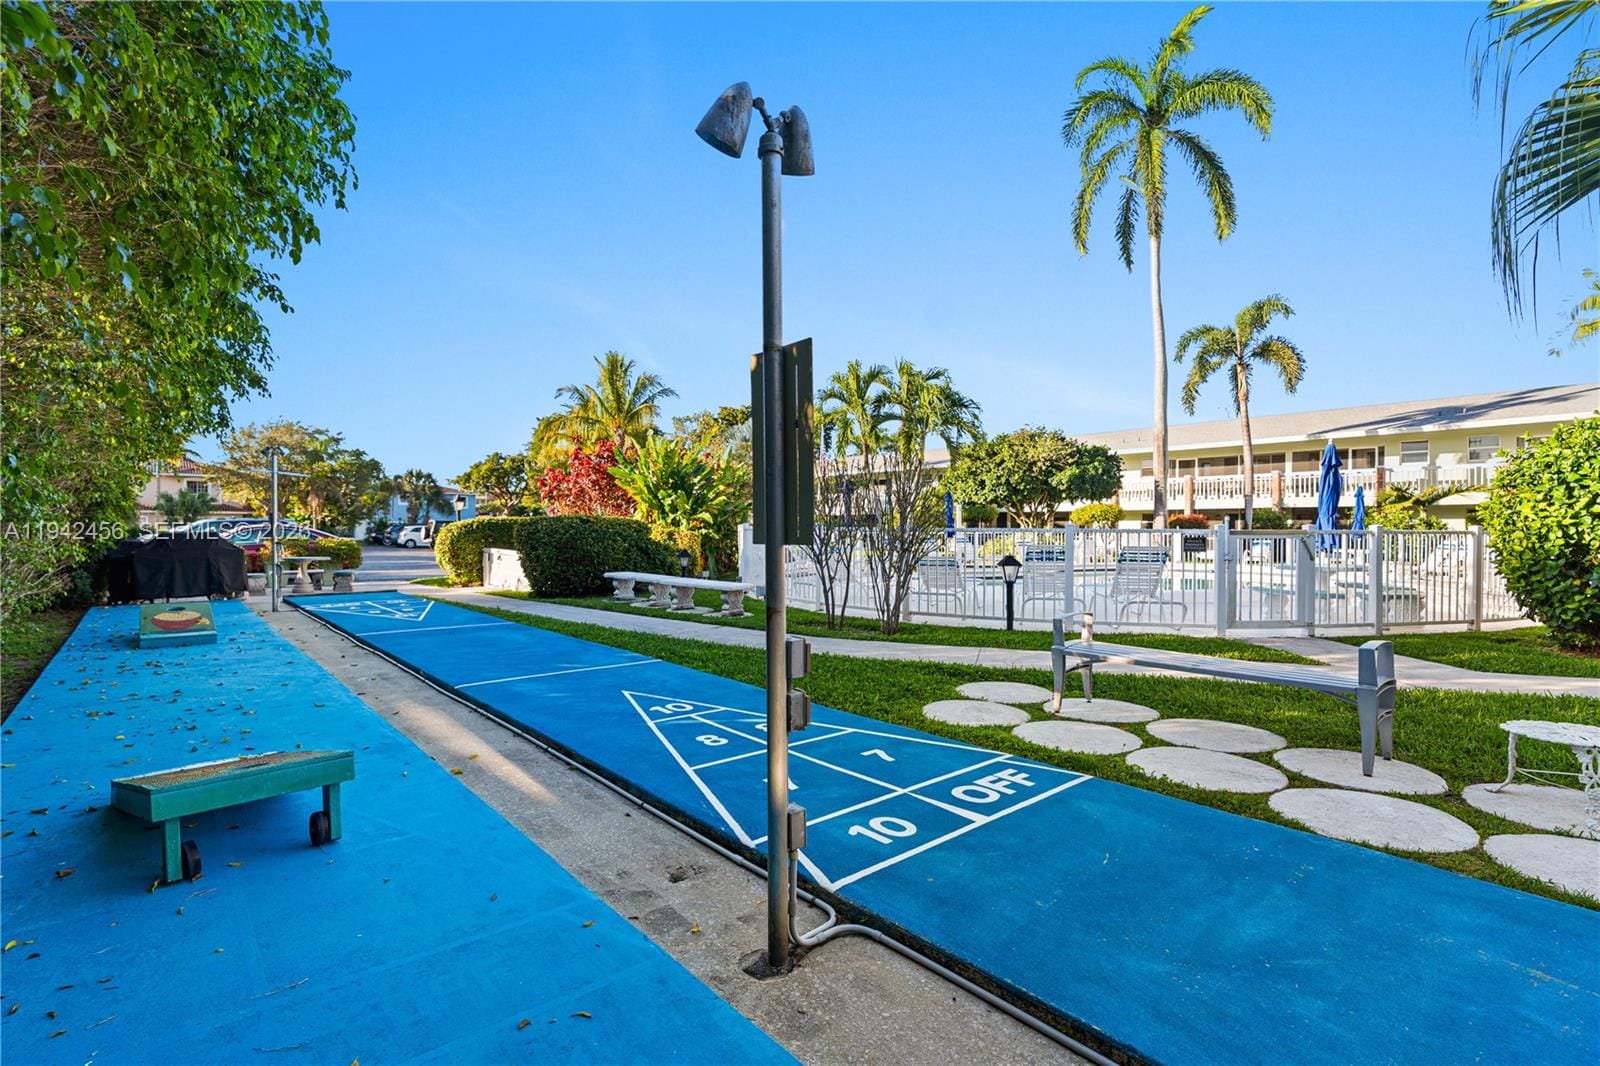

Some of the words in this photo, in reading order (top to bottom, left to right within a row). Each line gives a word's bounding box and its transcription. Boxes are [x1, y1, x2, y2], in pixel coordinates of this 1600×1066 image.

[649, 703, 694, 714] 10
[695, 734, 729, 746] 8
[860, 749, 896, 762] 7
[951, 768, 1036, 804] OFF
[848, 816, 917, 845] 10
